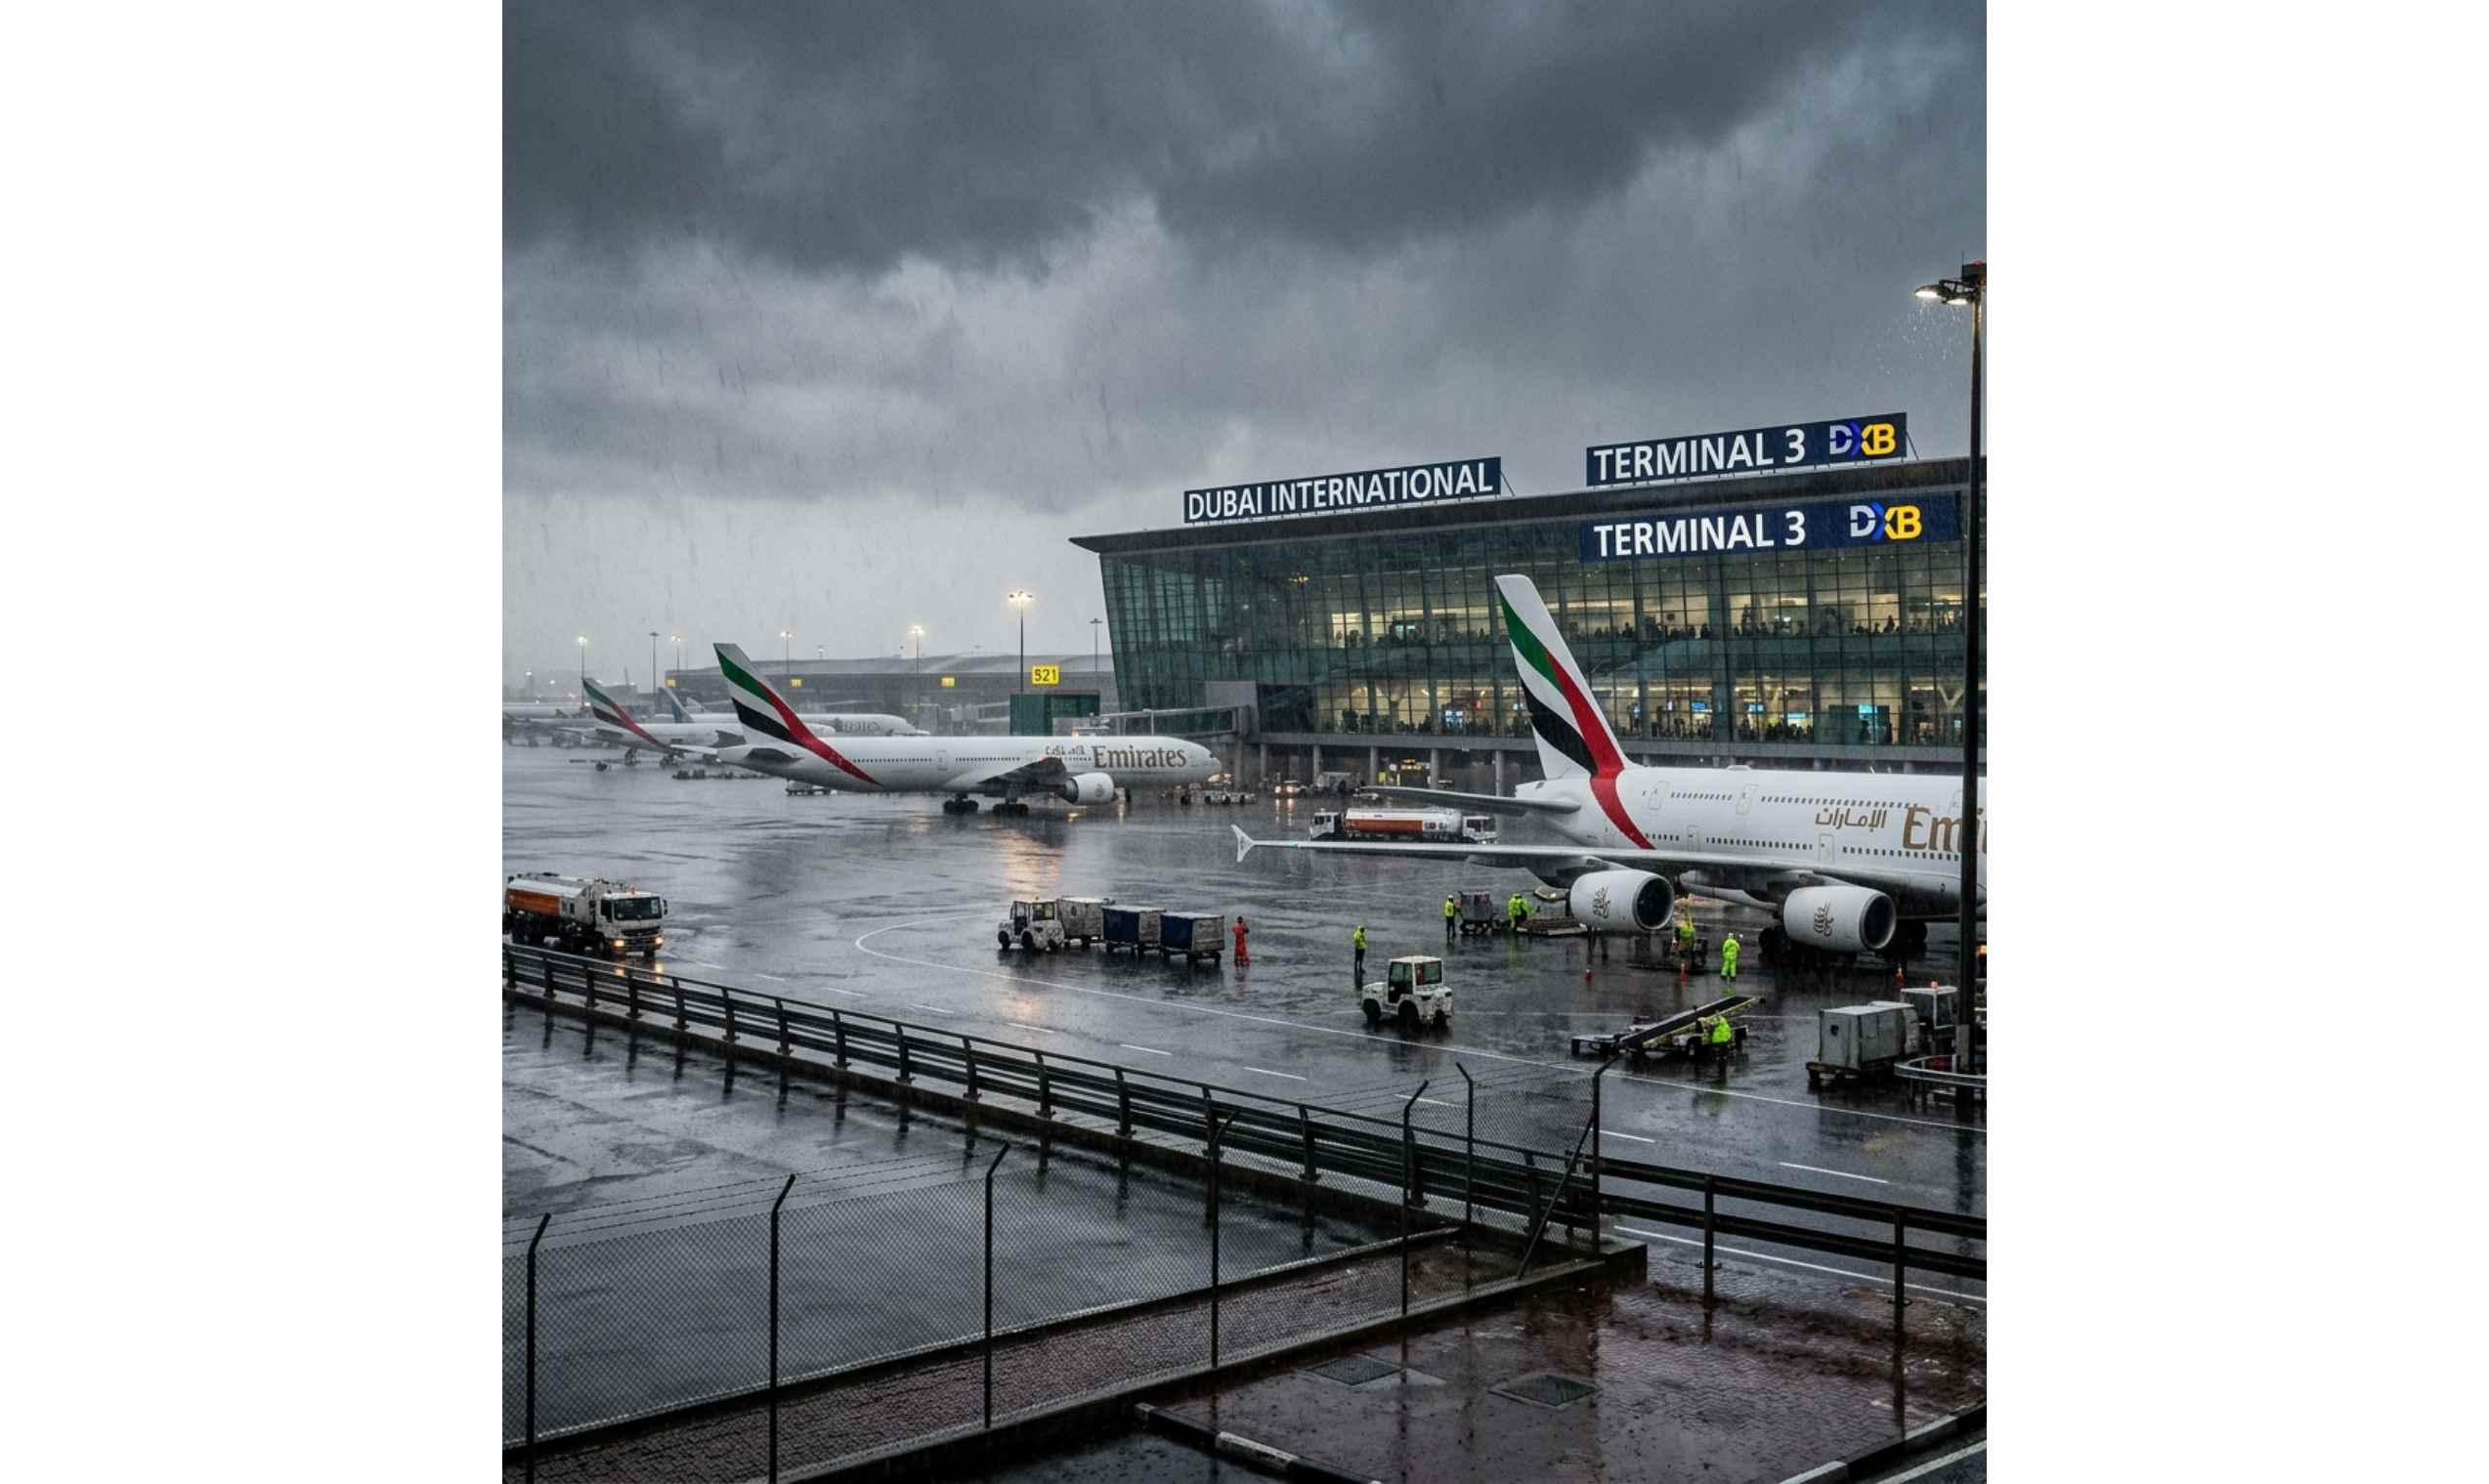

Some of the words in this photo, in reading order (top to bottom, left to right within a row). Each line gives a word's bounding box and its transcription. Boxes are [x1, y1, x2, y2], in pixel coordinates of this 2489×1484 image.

[1594, 433, 1774, 481] TERMINAL
[1784, 428, 1806, 463] 3
[1829, 422, 1896, 456] DXB
[1188, 487, 1263, 521] DUBAI
[1270, 462, 1493, 513] INTERNATIONAL
[1594, 514, 1774, 558] TERMINAL
[1784, 510, 1806, 546] 3
[1850, 501, 1922, 540] DXB
[1092, 745, 1186, 768] Emirates
